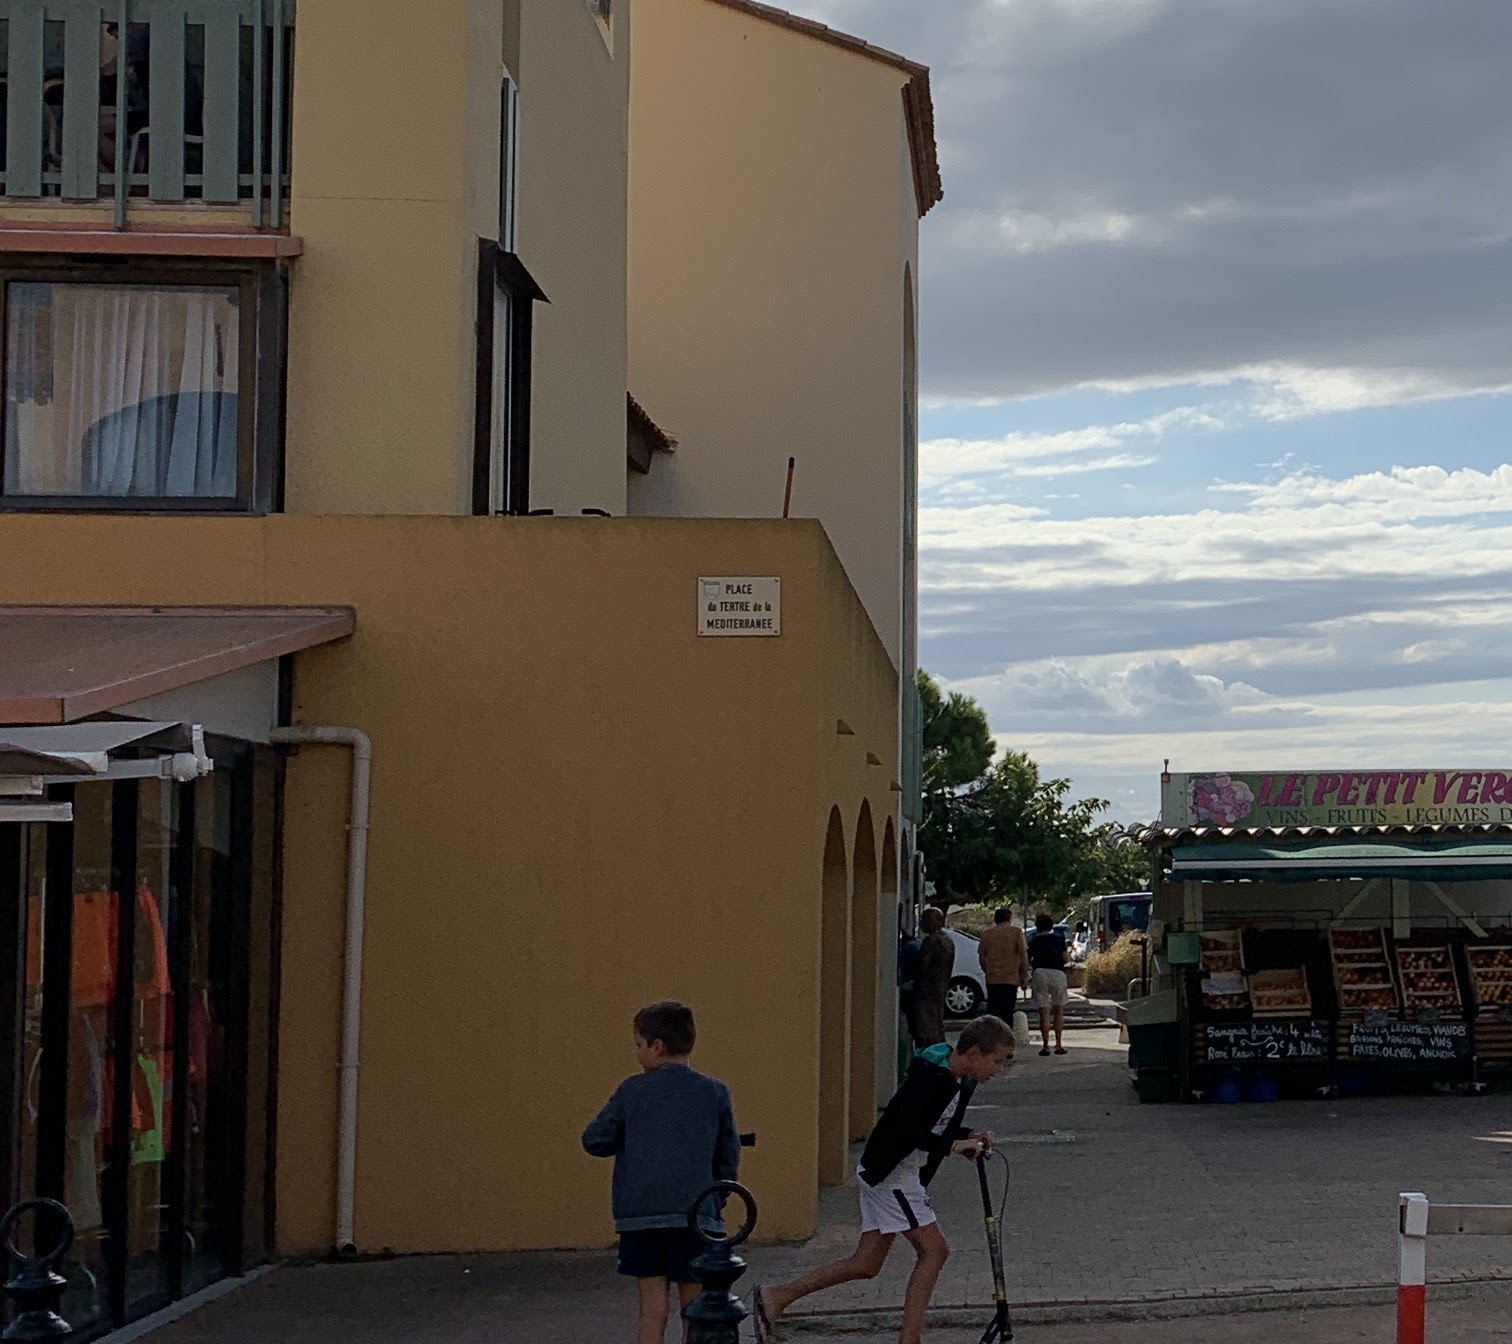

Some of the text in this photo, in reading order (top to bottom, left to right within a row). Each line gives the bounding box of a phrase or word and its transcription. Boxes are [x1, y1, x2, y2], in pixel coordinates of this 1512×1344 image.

[725, 583, 753, 595] PLACE
[719, 601, 751, 612] TERTRE
[753, 602, 762, 612] de
[764, 601, 772, 612] la
[706, 618, 773, 629] MEDITERRANEE
[1256, 773, 1307, 807] LE
[1311, 772, 1429, 806] PETIT
[1266, 809, 1309, 824] VINS
[1328, 808, 1388, 824] FRUITS
[1405, 807, 1490, 823] LEGUMES
